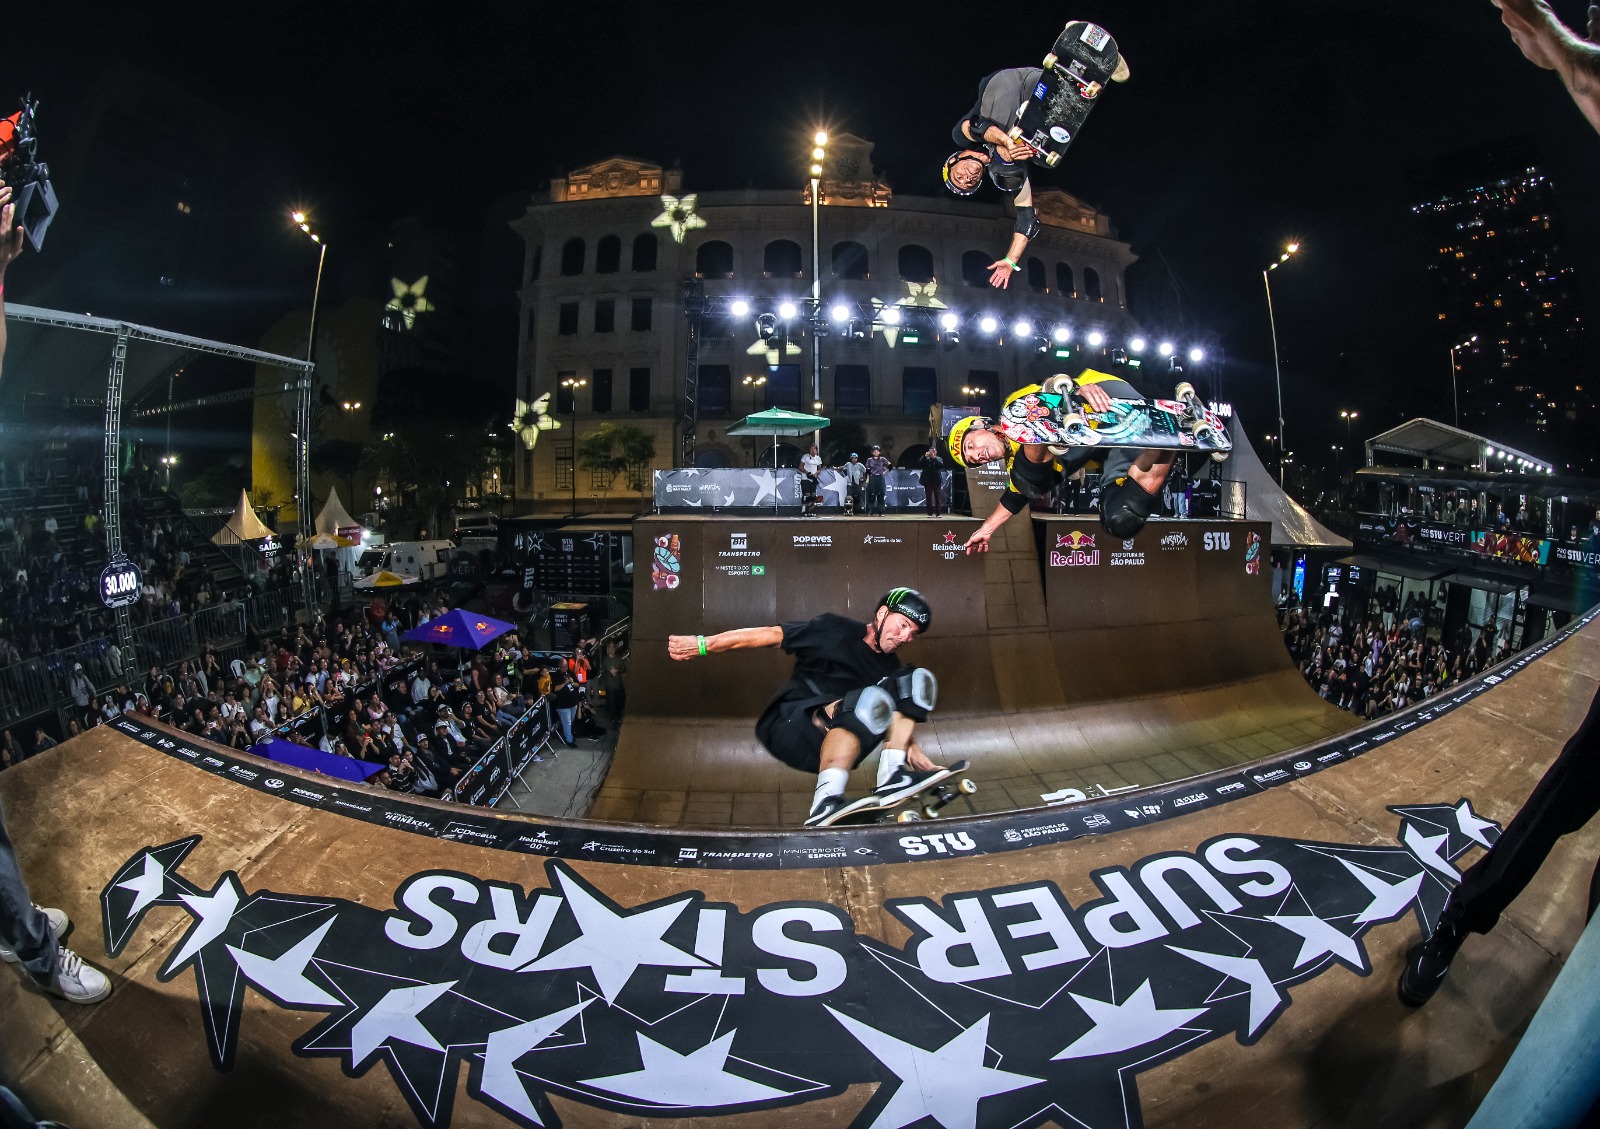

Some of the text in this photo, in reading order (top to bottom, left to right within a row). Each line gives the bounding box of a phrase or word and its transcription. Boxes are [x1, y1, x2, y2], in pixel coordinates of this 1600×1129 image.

[952, 429, 964, 457] VANS
[1203, 531, 1231, 551] STU
[1429, 529, 1442, 539] STU
[1443, 531, 1465, 543] VERT
[258, 541, 282, 552] SAÍDA
[1050, 551, 1099, 567] Red Bull
[1110, 558, 1145, 566] SÃO PAULO
[1567, 549, 1582, 561] STU
[1582, 551, 1600, 565] VER
[105, 571, 137, 596] 30.000
[385, 814, 431, 828] HEINEKEN
[450, 827, 498, 841] JCDecaux
[1041, 826, 1070, 836] PAULO
[518, 835, 560, 846] Heineken
[898, 831, 977, 856] STU
[599, 846, 631, 854] Cruzeiro
[702, 851, 774, 859] TRANSPETRO
[808, 851, 848, 859] ESPORTE
[895, 838, 1292, 983] SUPER
